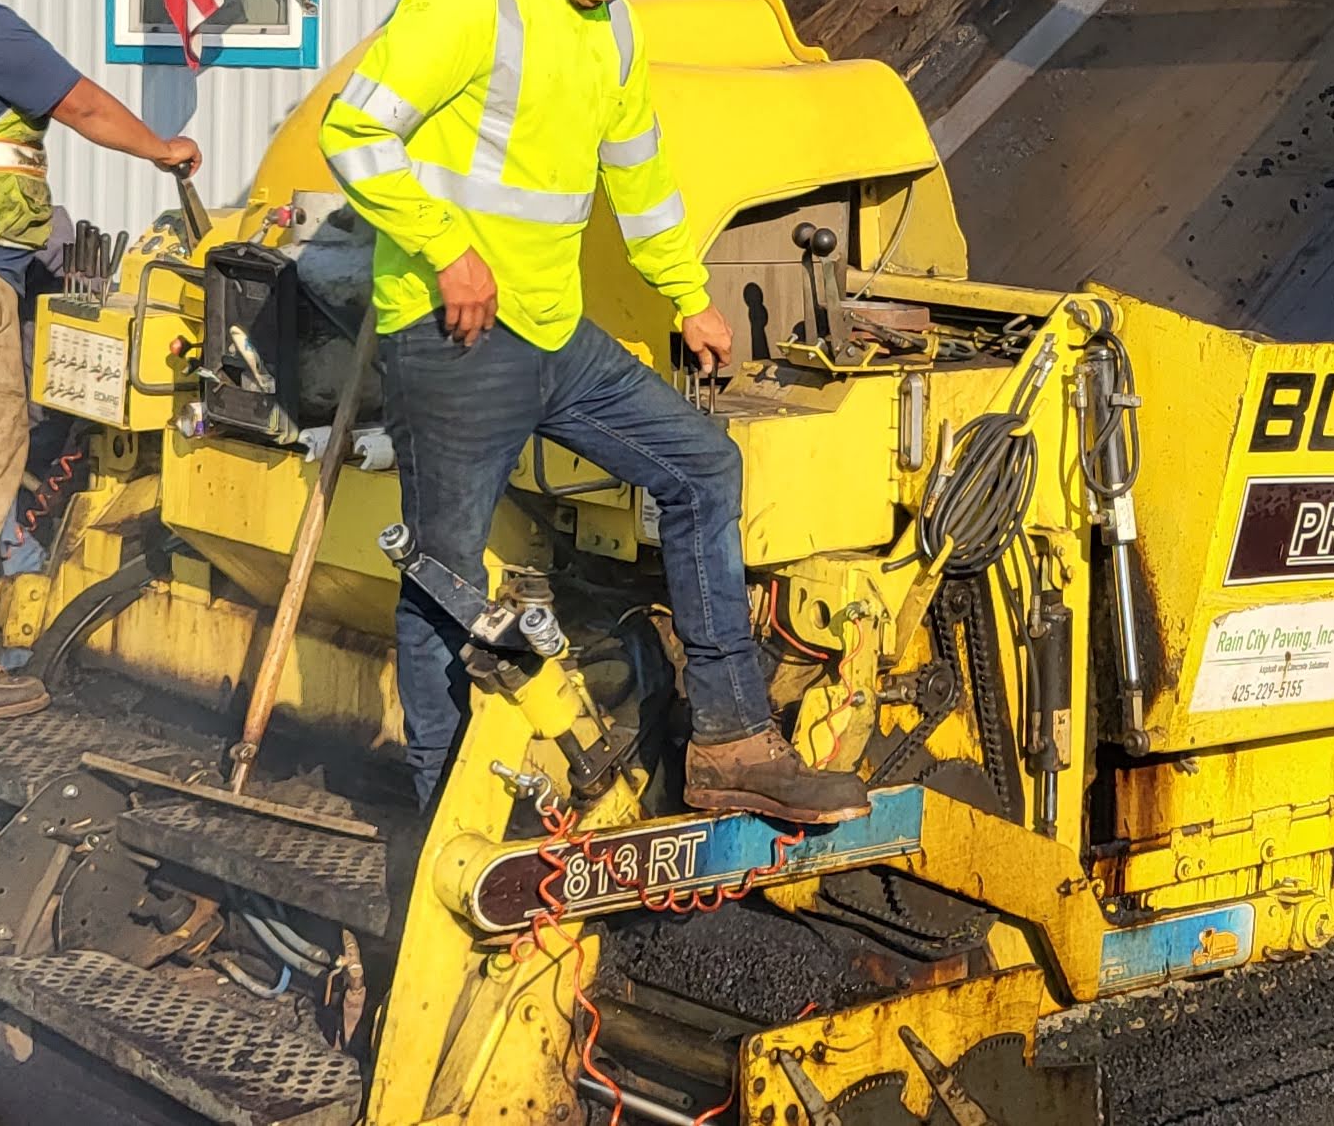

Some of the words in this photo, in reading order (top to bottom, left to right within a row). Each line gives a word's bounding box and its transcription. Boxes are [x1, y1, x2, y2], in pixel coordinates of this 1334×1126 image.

[1216, 630, 1244, 653] Rain
[1246, 628, 1271, 655] City
[1271, 626, 1313, 652] Paving,
[1231, 679, 1305, 704] 425-229-5155
[562, 843, 639, 901] 813
[647, 830, 707, 886] RT
